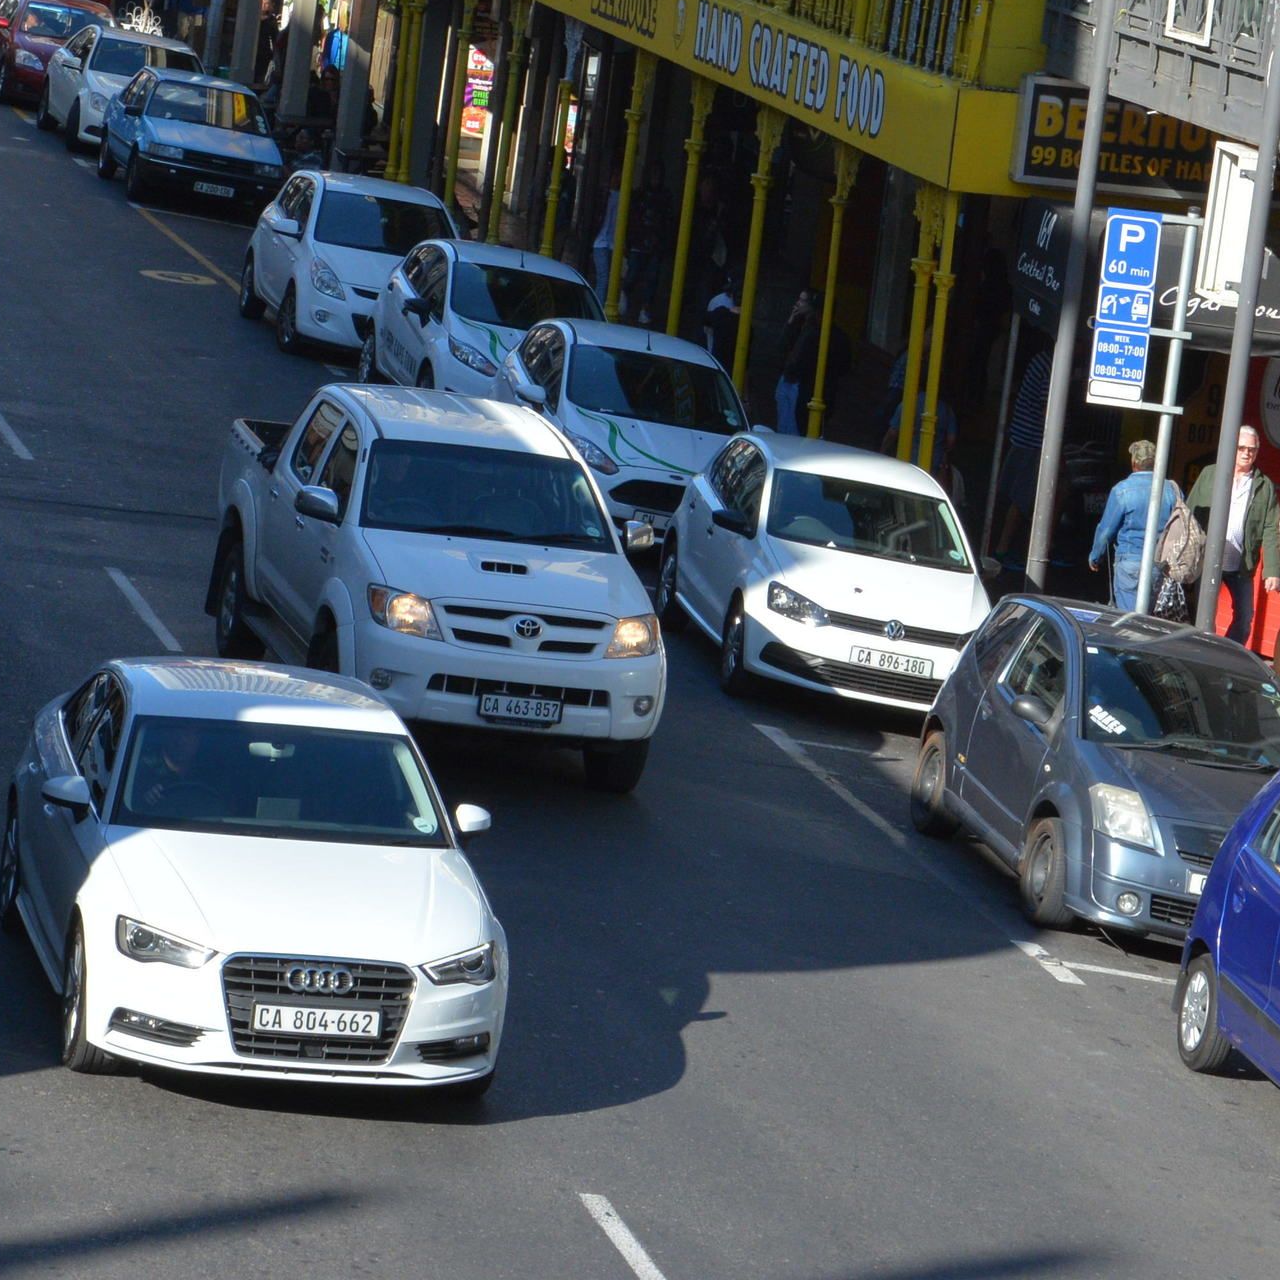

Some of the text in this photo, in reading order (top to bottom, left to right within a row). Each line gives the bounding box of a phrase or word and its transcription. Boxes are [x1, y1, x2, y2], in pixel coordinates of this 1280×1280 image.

[748, 20, 830, 113] CRAFTED
[834, 54, 885, 139] FOOD
[1031, 145, 1057, 166] 99
[1060, 147, 1145, 175] BOTLES
[1146, 156, 1173, 177] OF
[1036, 209, 1058, 251] 169
[1119, 223, 1146, 253] P
[1108, 259, 1150, 278] 60 min
[1114, 334, 1131, 344] WEEK
[1114, 357, 1126, 366] SAT
[857, 649, 925, 675] CA 896-180
[483, 696, 559, 718] CA 463-857
[259, 1007, 373, 1034] CA 804-662
